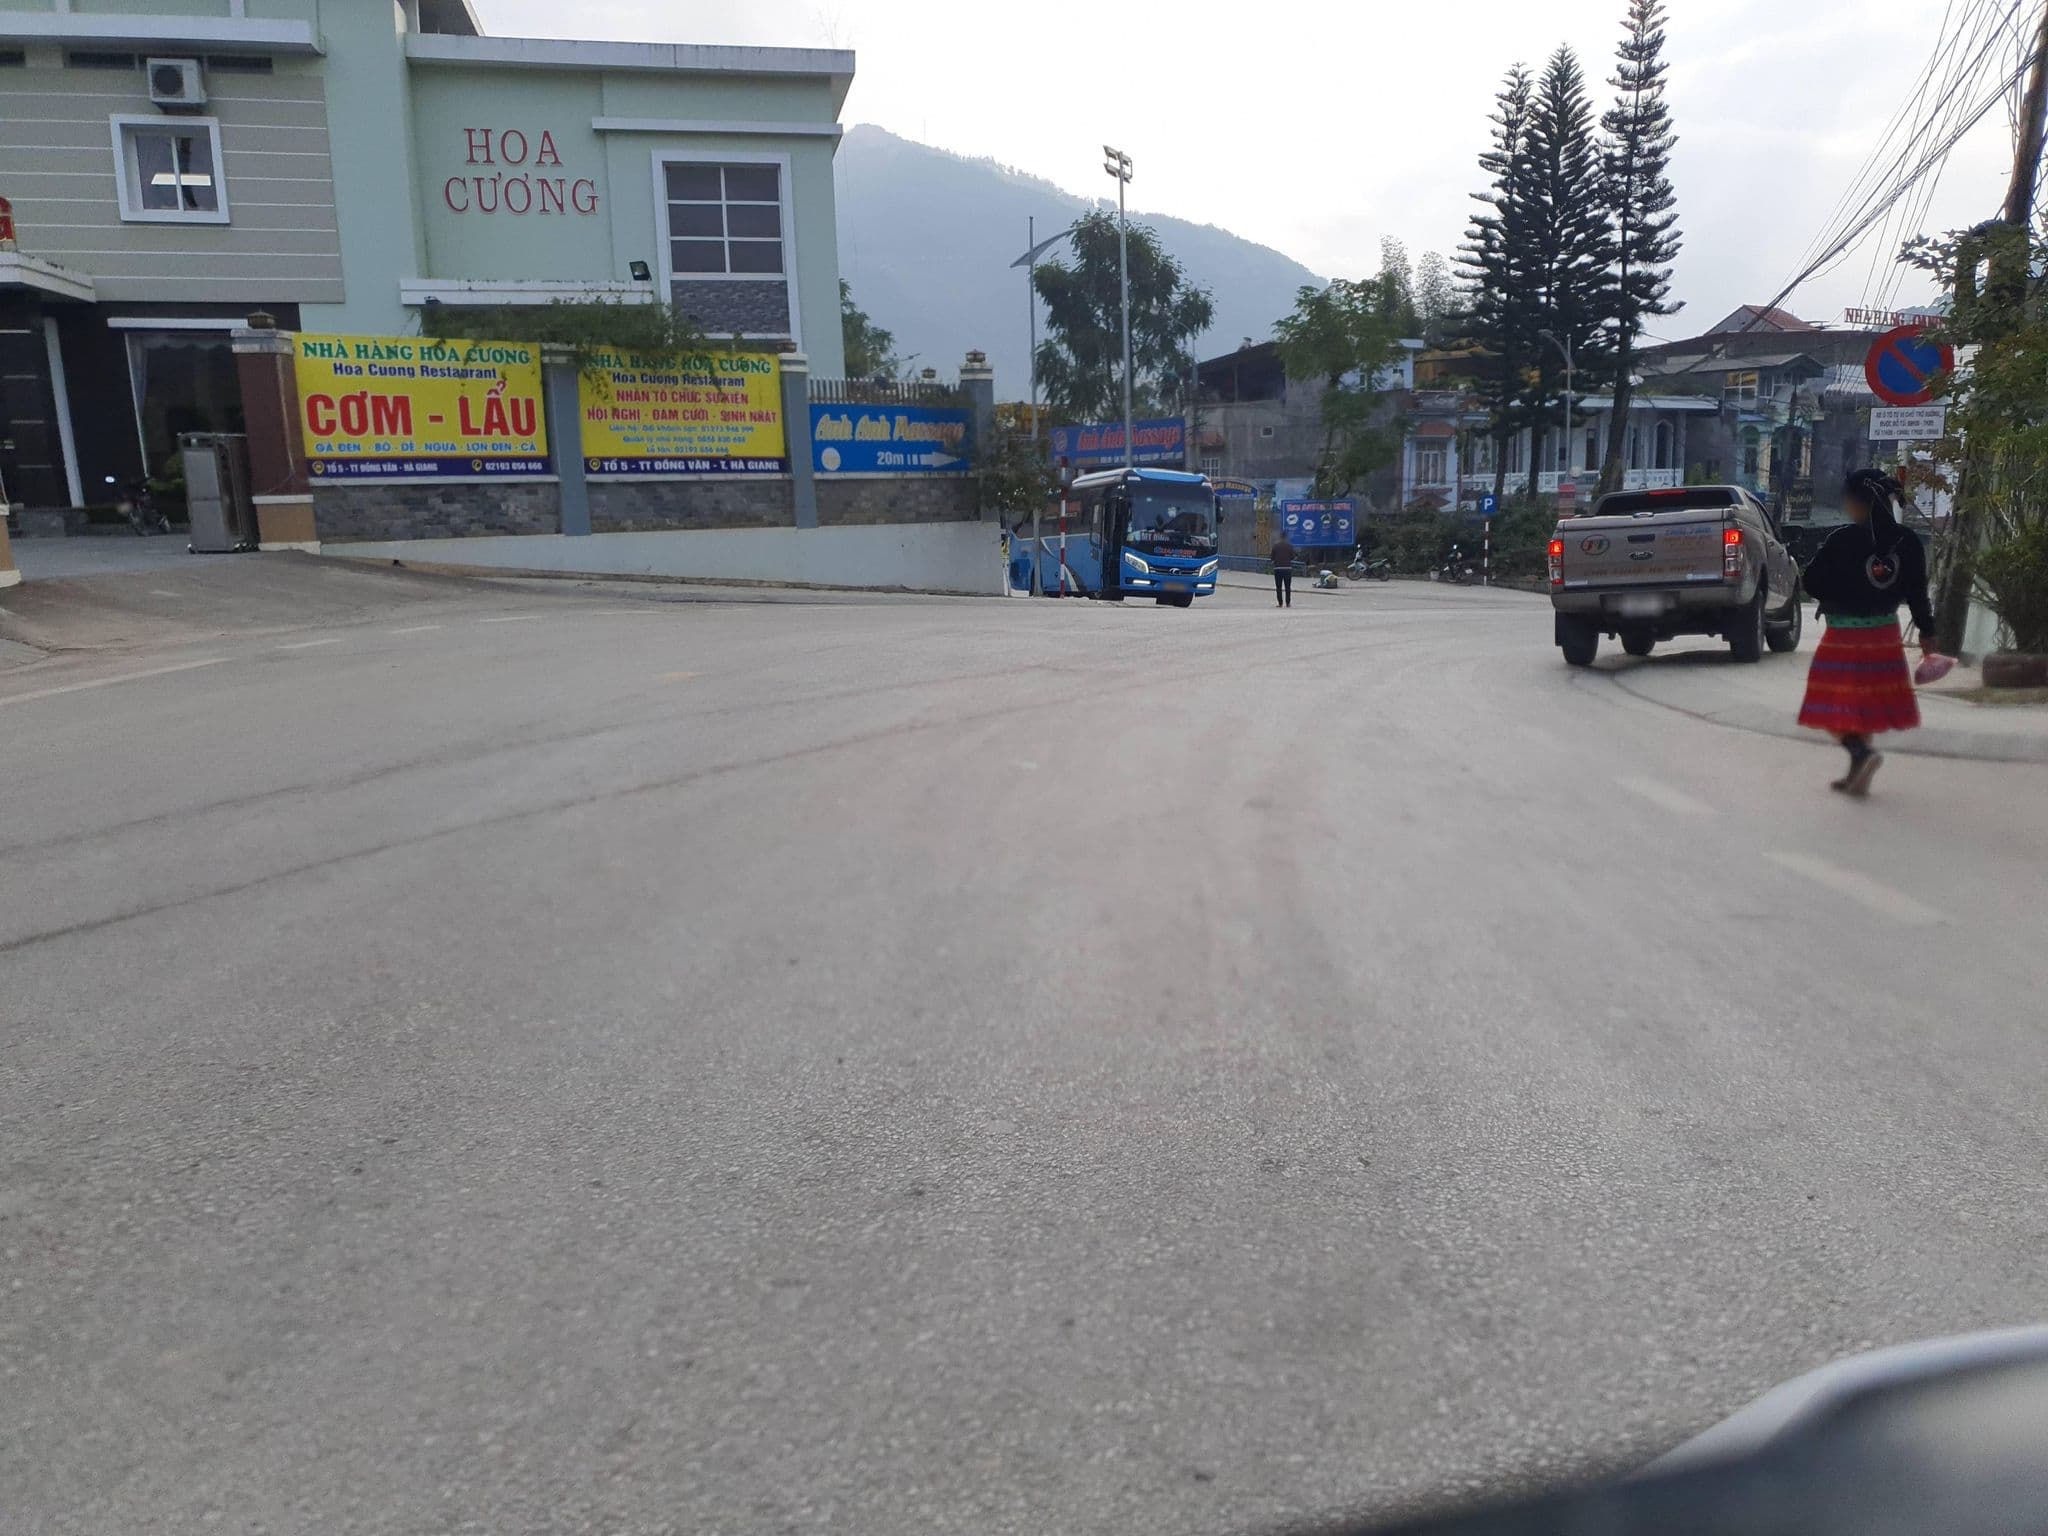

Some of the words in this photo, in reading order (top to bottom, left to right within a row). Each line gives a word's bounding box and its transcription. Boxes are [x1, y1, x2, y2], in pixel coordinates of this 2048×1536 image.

[463, 128, 564, 165] HOA
[444, 171, 600, 214] CƯƠNG
[302, 339, 349, 358] NHÀ
[355, 340, 413, 361] HÀNG
[419, 346, 460, 362] HOA
[466, 347, 530, 365] CƯƠNG
[333, 363, 363, 375] Hoa
[368, 364, 415, 378] Cuong
[420, 365, 497, 380] Restaurant
[612, 372, 636, 384] Hoa
[640, 374, 679, 386] Cuong
[682, 374, 745, 388] Restaurant
[306, 390, 413, 437] CƠM
[459, 380, 537, 437] LẨU
[603, 458, 618, 471] TỔ
[876, 451, 904, 466] 20m
[1484, 498, 1494, 510] P
